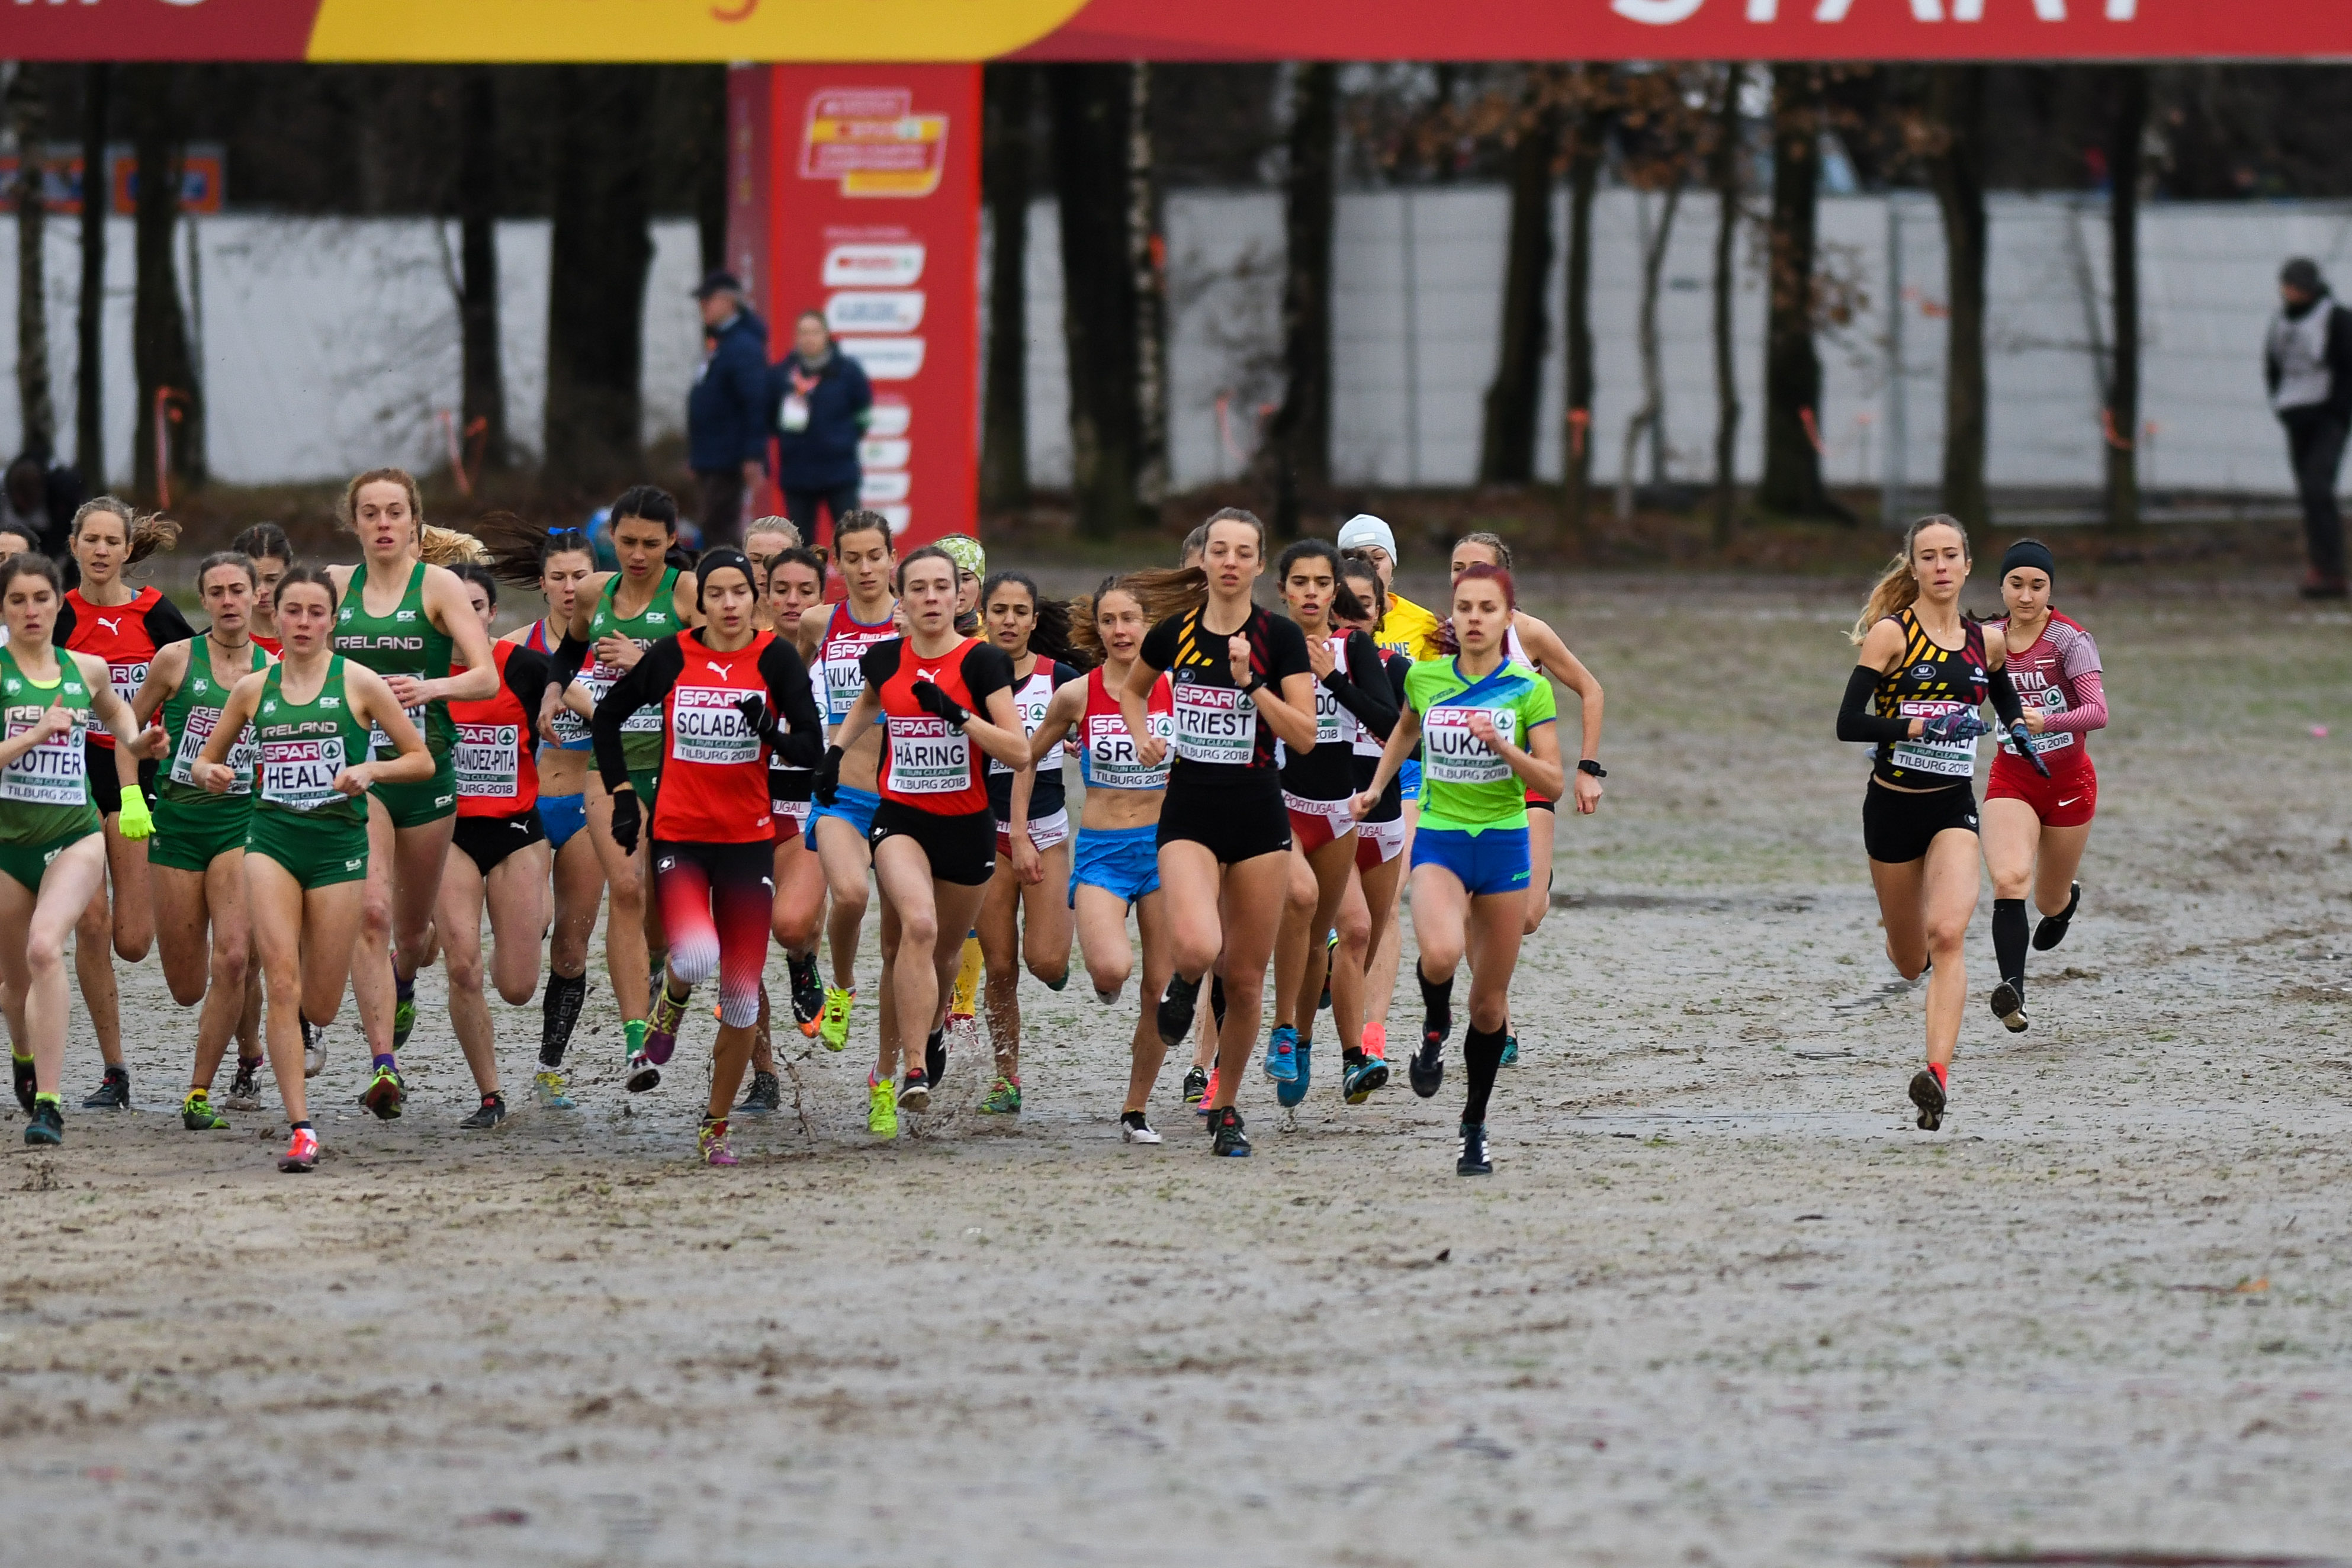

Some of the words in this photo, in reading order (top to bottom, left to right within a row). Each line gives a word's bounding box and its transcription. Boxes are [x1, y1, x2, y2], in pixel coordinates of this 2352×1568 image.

[335, 636, 423, 650] IRELAND
[830, 644, 868, 658] SPA
[2007, 671, 2049, 690] TVIA
[1176, 689, 1233, 708] SPAR
[643, 719, 661, 728] 201
[891, 721, 943, 735] SPAR
[1177, 708, 1252, 736] TRIEST
[262, 722, 338, 738] IRELAND
[2047, 735, 2070, 748] 2018
[266, 745, 319, 761] SPAR
[681, 747, 728, 761] TILBURG
[731, 749, 756, 761] 2018
[895, 742, 965, 767] HÄRING
[1180, 744, 1220, 759] TILBURG
[1223, 750, 1249, 760] 2018
[1898, 754, 1946, 772] TILBURG
[1948, 763, 1969, 773] 2018
[268, 762, 341, 789] HEALY
[1095, 770, 1142, 785] TILBURG
[456, 782, 484, 793] BURG
[487, 784, 513, 793] 2018
[895, 778, 938, 790] TILBURG
[941, 777, 966, 789] 2018
